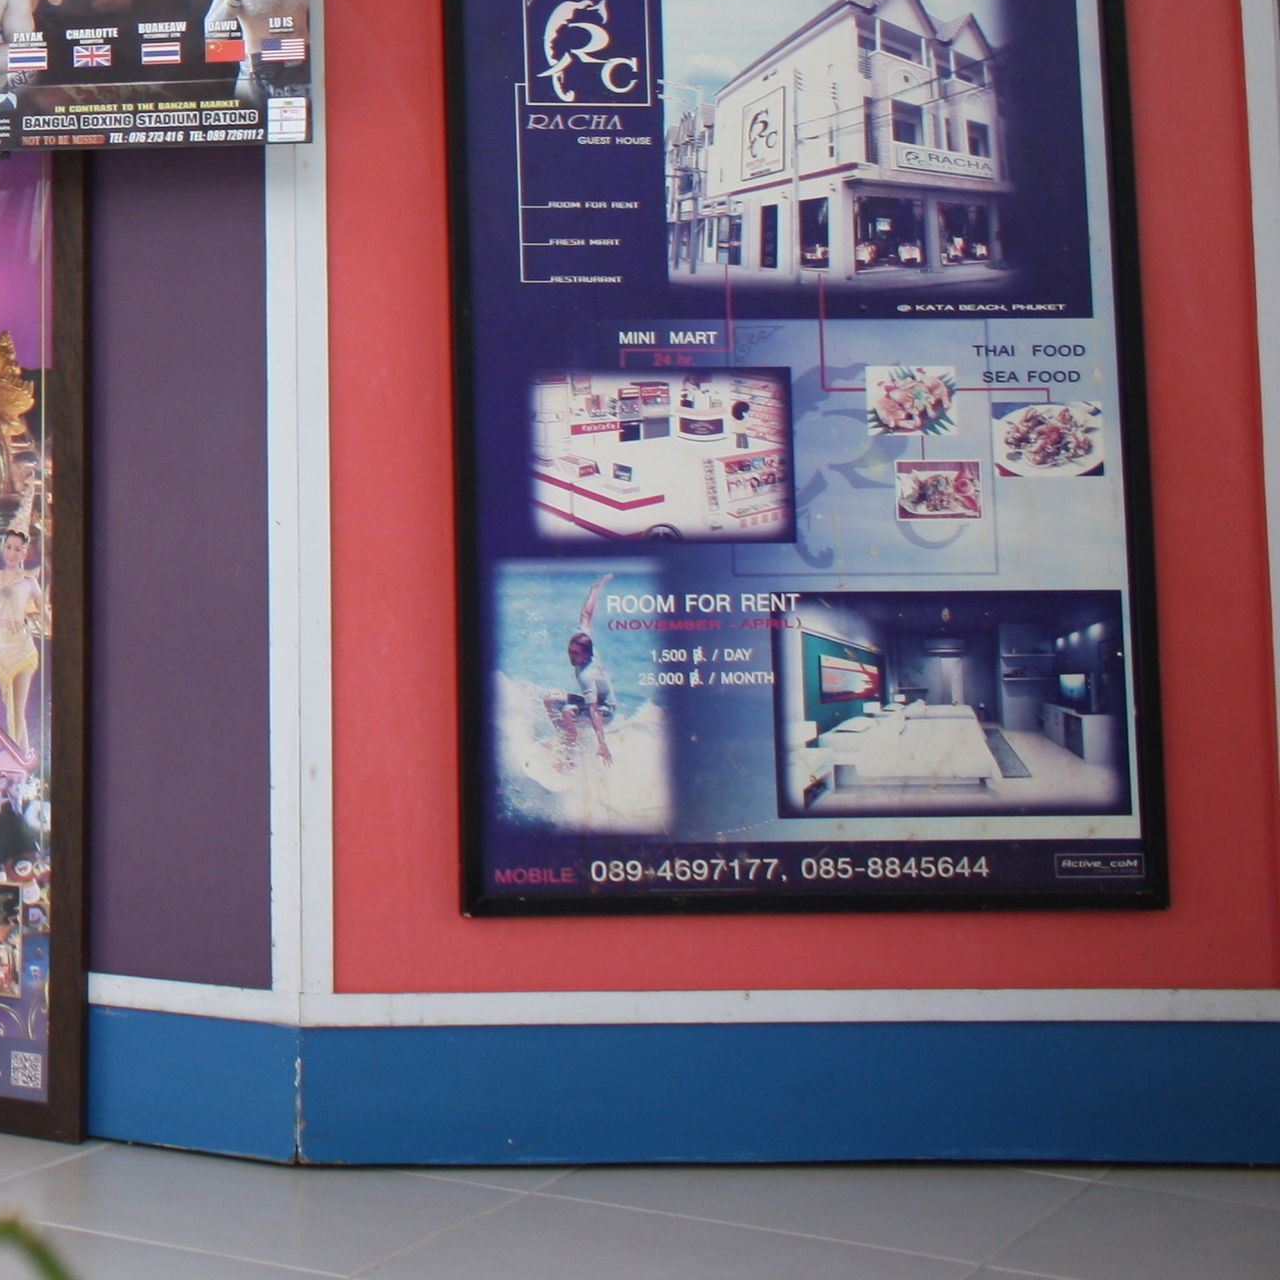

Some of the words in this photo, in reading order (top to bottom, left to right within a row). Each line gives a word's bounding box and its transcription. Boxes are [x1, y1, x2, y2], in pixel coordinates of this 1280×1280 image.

[65, 27, 119, 41] CHARLOTTE
[137, 20, 187, 35] BUAKEAW
[12, 31, 44, 44] PAYAK
[67, 103, 120, 113] CONTRAST
[157, 100, 198, 111] BANZAN
[199, 99, 241, 110] MARKET
[22, 114, 78, 131] BANGLA
[80, 113, 133, 129] BOXING
[135, 111, 200, 128] STADIUM
[201, 109, 258, 126] PATONG
[525, 113, 624, 131] RACHA
[577, 136, 611, 146] GUEST
[615, 136, 652, 146] HOUSE
[611, 200, 640, 209] RENT
[549, 275, 623, 284] RESTAURANT
[914, 303, 954, 312] KATA
[958, 303, 1010, 313] BEACH,
[1011, 303, 1068, 312] PHUKET
[618, 331, 656, 345] MINI
[669, 330, 718, 345] MART
[972, 344, 1017, 359] THAI
[1031, 344, 1087, 359] FOOD
[652, 353, 673, 367] 24
[981, 369, 1021, 385] SEA
[1026, 369, 1082, 385] FOOD
[606, 594, 676, 613] ROOM
[684, 593, 732, 613] FOR
[740, 593, 801, 612] RENT
[607, 619, 722, 632] (NOVEMBER
[740, 617, 803, 630] APRIL)
[649, 648, 688, 664] 1,500
[723, 648, 753, 662] DAY
[638, 671, 685, 687] 25,000
[720, 671, 776, 686] MONTH
[589, 857, 788, 883] 089-4697177,
[800, 855, 991, 881] 085-8845644
